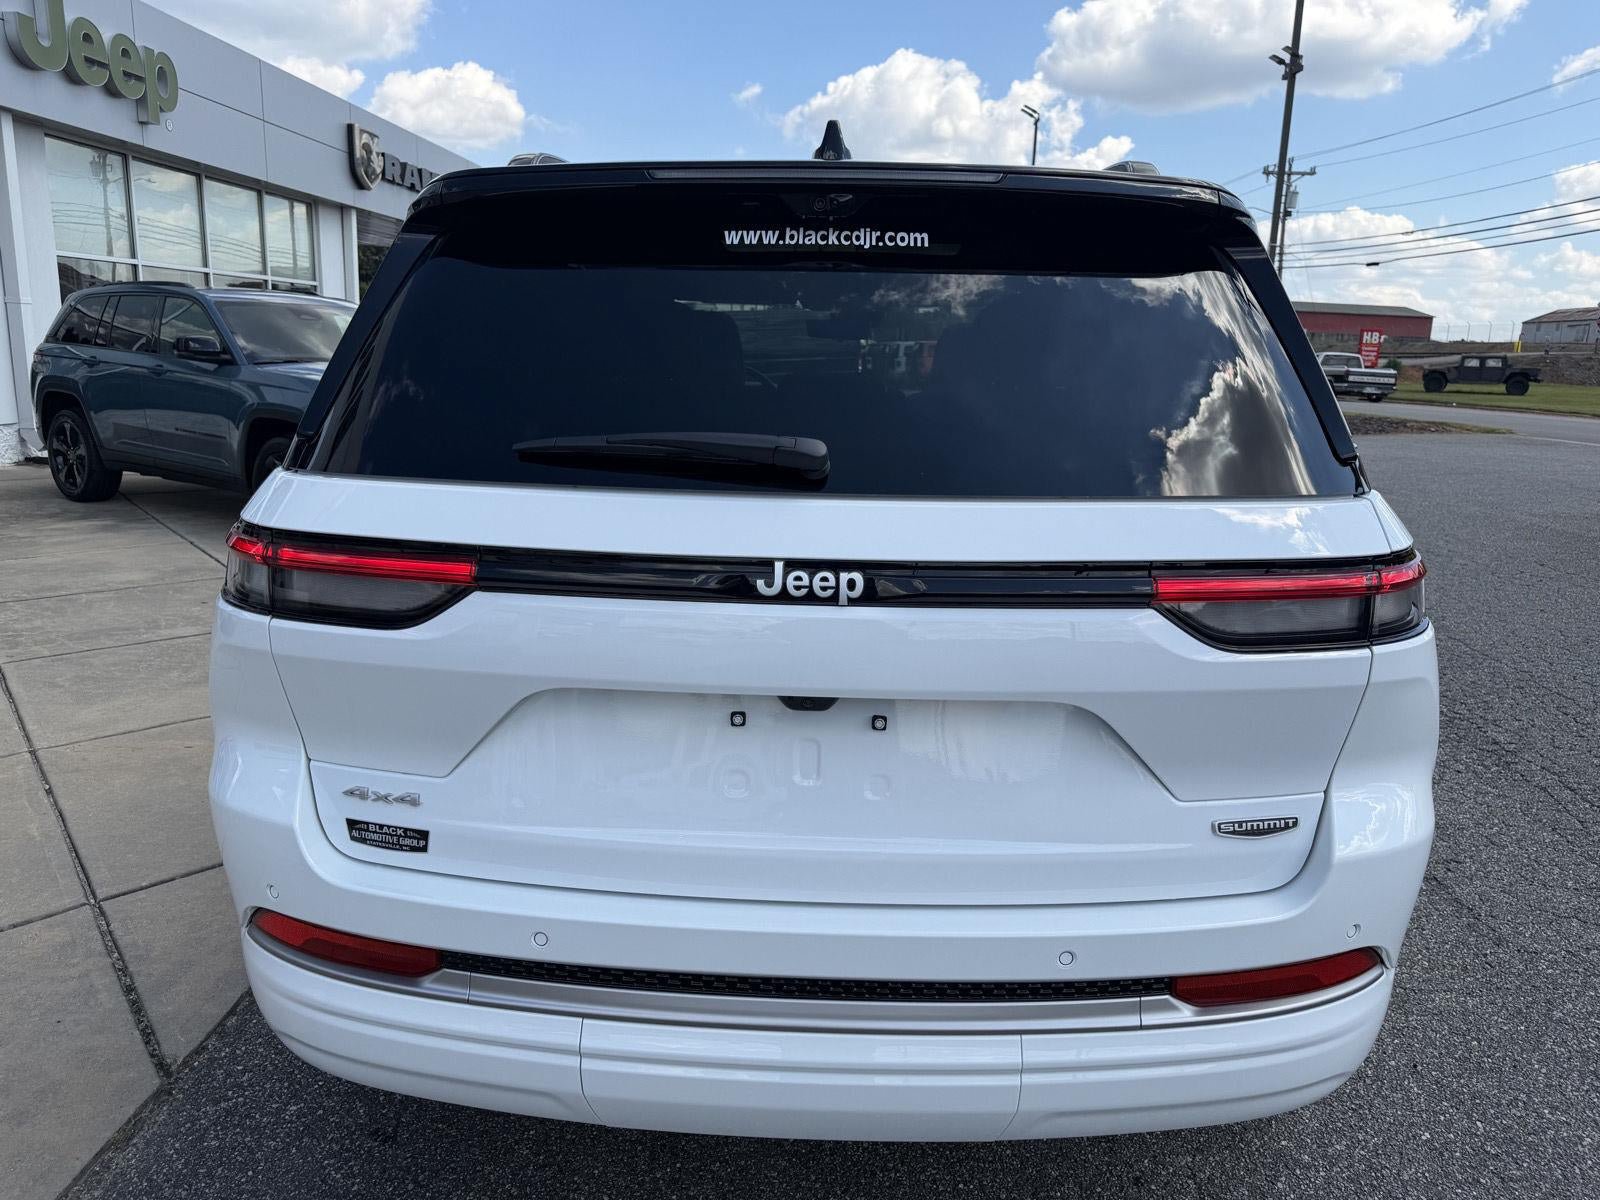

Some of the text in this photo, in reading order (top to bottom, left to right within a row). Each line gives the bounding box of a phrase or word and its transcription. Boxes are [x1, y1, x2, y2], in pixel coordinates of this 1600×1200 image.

[4, 0, 179, 125] Jeep
[723, 226, 930, 249] www.blackcdjr.com
[756, 560, 864, 606] Jeep
[342, 785, 421, 807] 4x4
[368, 823, 405, 836] BLACK
[1219, 819, 1297, 832] SUMMIT
[351, 829, 426, 848] AUTOMOTIVE GROUP
